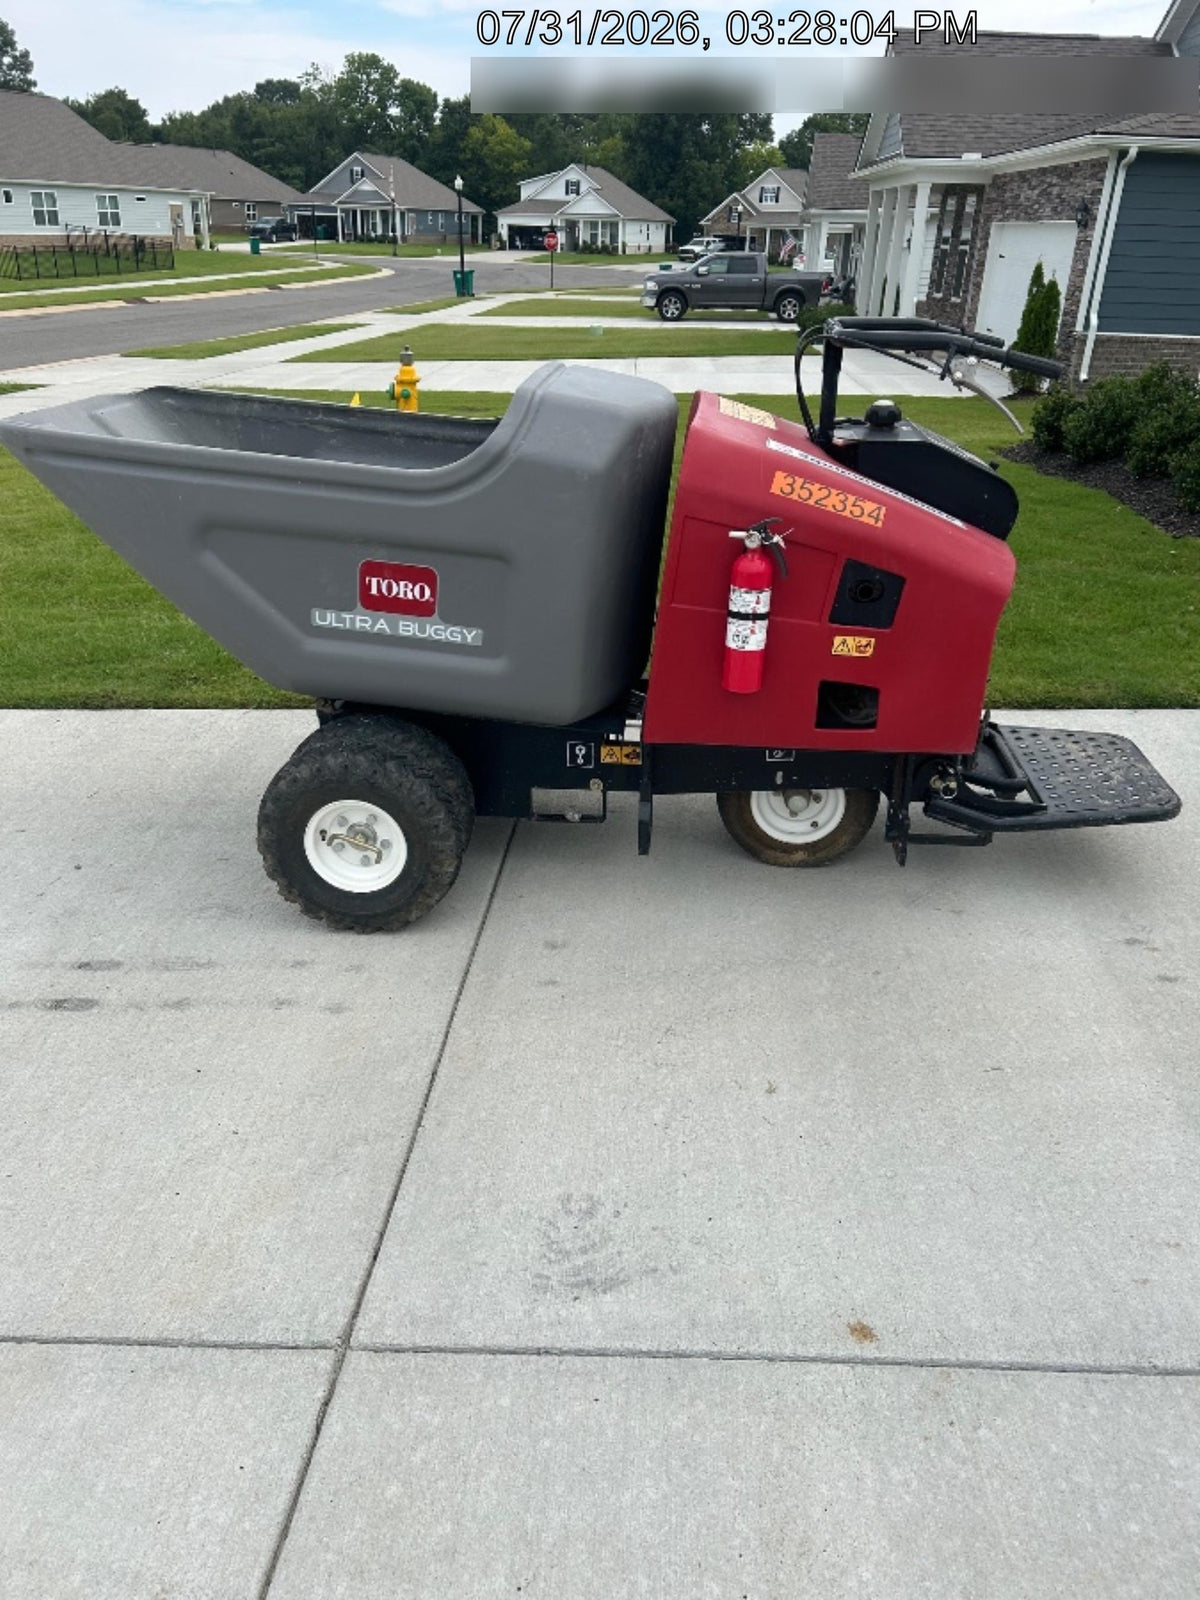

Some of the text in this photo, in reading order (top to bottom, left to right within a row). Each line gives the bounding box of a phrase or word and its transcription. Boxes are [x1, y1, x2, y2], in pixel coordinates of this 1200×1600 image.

[779, 473, 884, 526] 352354
[365, 576, 432, 602] TORO
[315, 610, 477, 643] ULTRA BUGGY
